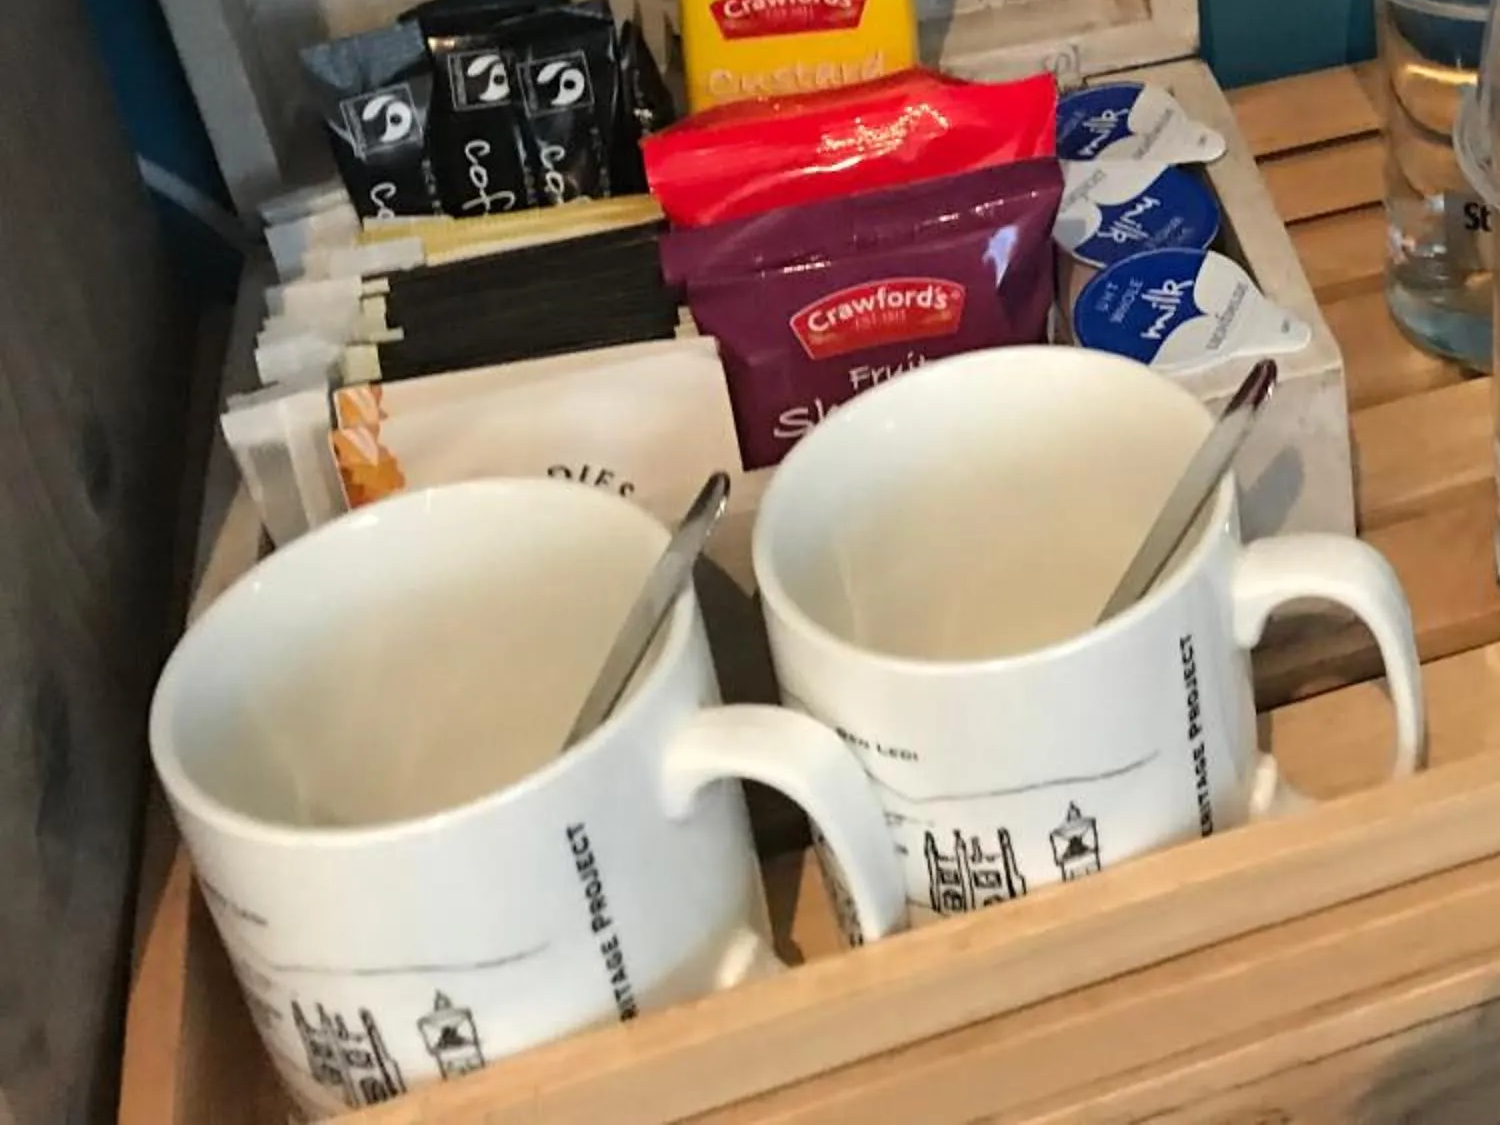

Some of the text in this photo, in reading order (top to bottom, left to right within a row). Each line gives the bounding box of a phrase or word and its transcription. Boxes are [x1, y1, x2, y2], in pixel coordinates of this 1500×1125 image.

[807, 285, 948, 332] Crawford's
[1179, 634, 1202, 741] PROJECT
[566, 822, 613, 935] PROJECT
